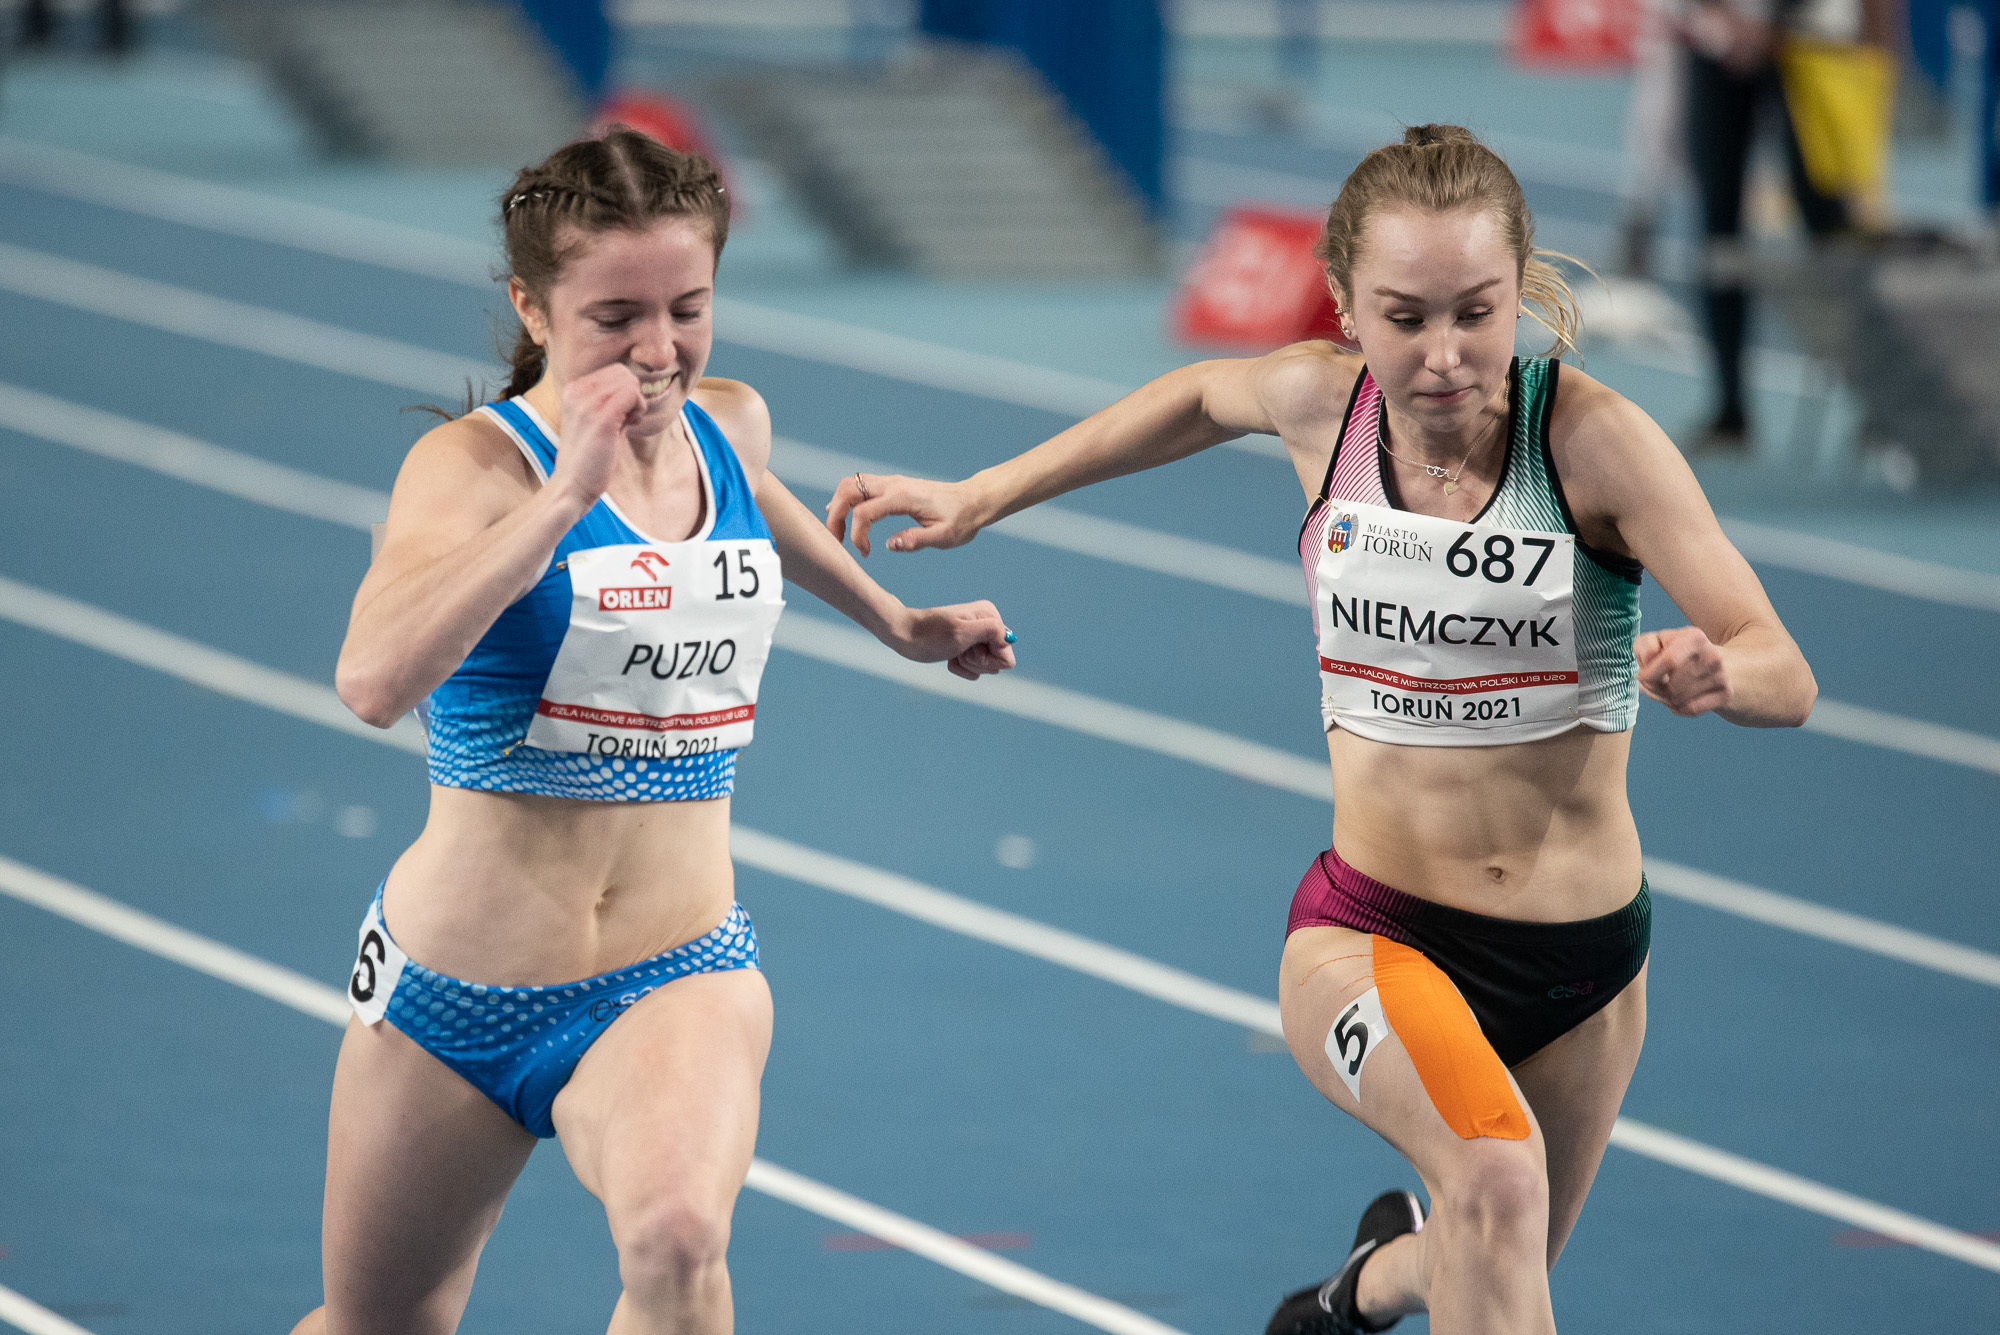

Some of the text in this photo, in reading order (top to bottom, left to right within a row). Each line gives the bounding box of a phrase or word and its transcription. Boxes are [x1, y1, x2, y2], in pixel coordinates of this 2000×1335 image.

[1361, 534, 1433, 563] TORUŃ
[1367, 523, 1419, 542] MIASTO
[1445, 530, 1556, 587] 687
[713, 549, 760, 601] 15
[602, 588, 669, 609] ORLEN
[1331, 592, 1560, 648] NIEMCZYK
[621, 638, 737, 680] PUZIO
[1330, 662, 1567, 690] PZLA HALOWE MISTRZOSTWA POLSKI U18 U20
[549, 706, 578, 718] PZLA
[580, 709, 625, 725] HALOWE
[627, 716, 694, 729] MISTRZOSTWA
[695, 714, 721, 726] POLSKI
[1370, 689, 1521, 721] TORUŃ 2021
[586, 733, 718, 759] TORUŃ 2021
[351, 929, 386, 1003] 6
[1334, 1003, 1369, 1076] 5
